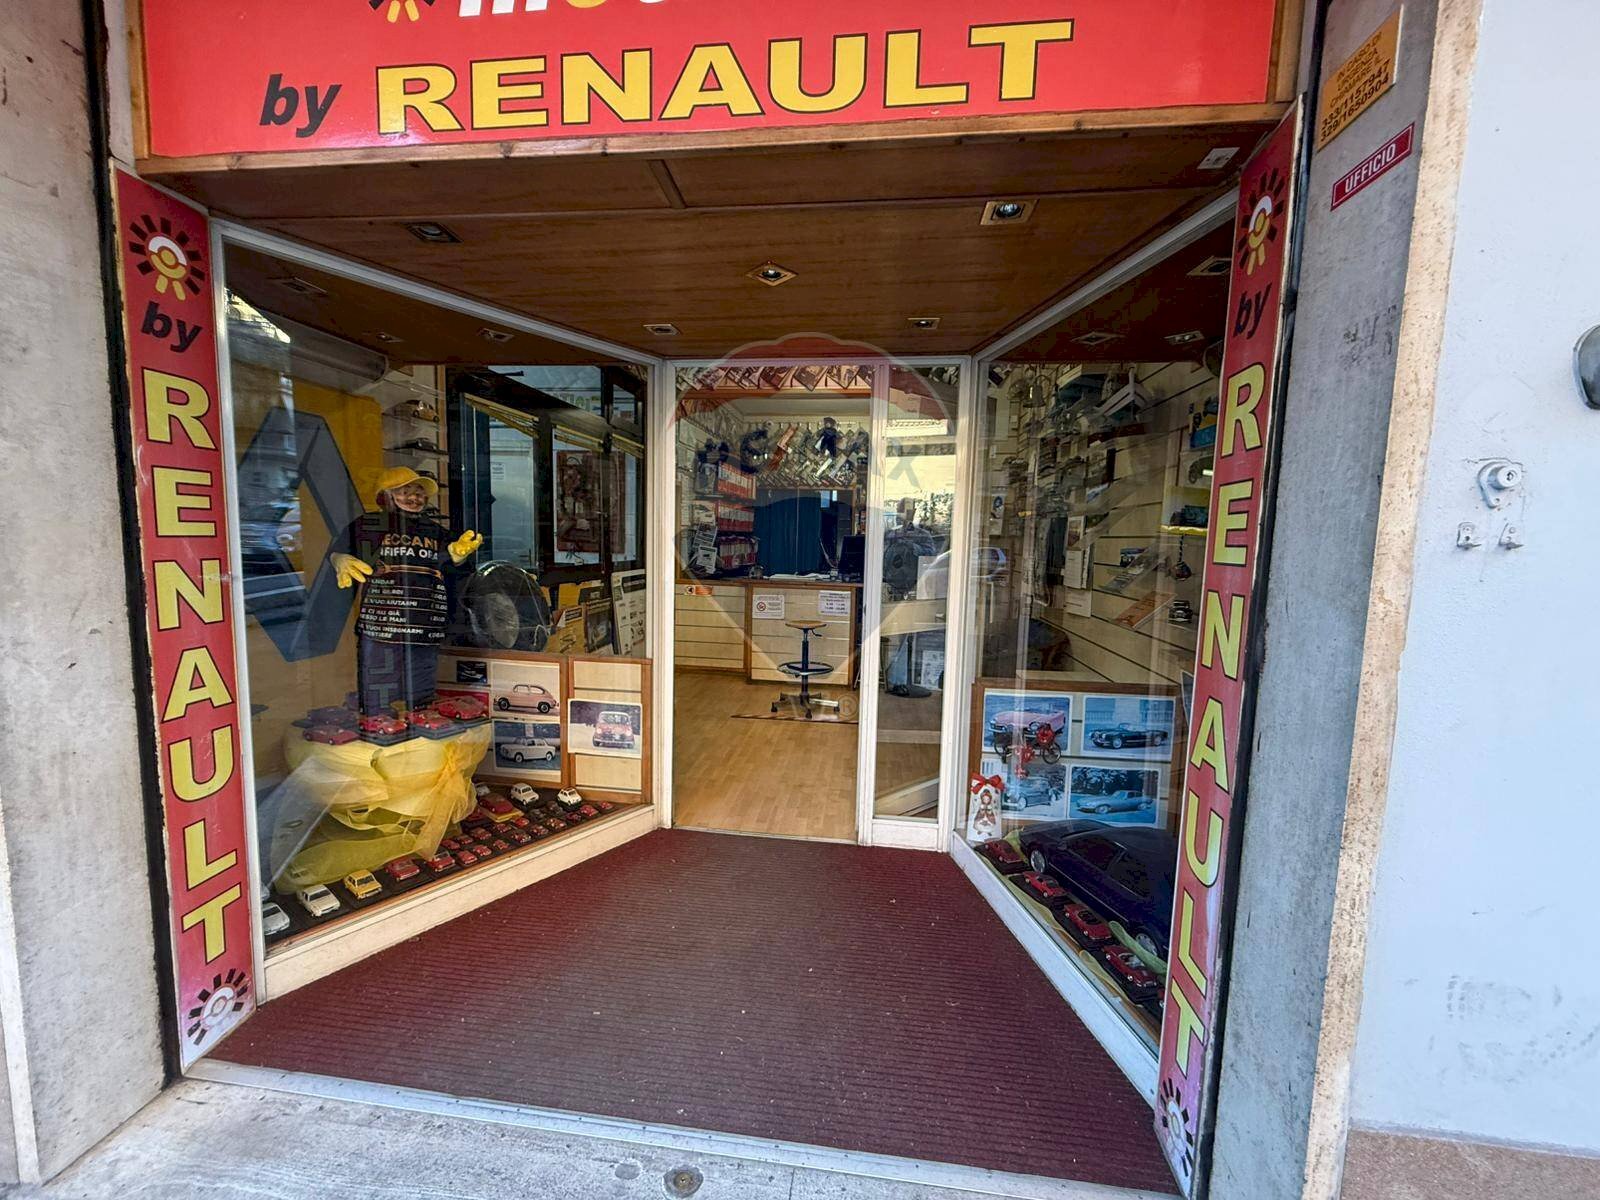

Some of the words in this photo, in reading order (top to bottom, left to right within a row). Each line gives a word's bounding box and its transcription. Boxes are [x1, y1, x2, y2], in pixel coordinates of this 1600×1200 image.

[258, 73, 342, 138] by
[375, 18, 1075, 135] RENAULT
[1344, 142, 1396, 194] UFFICIO
[141, 300, 203, 353] by
[1232, 283, 1273, 341] by
[381, 533, 438, 551] ECCANI
[141, 366, 243, 965] RENAULT
[1170, 361, 1267, 1080] RENAULT
